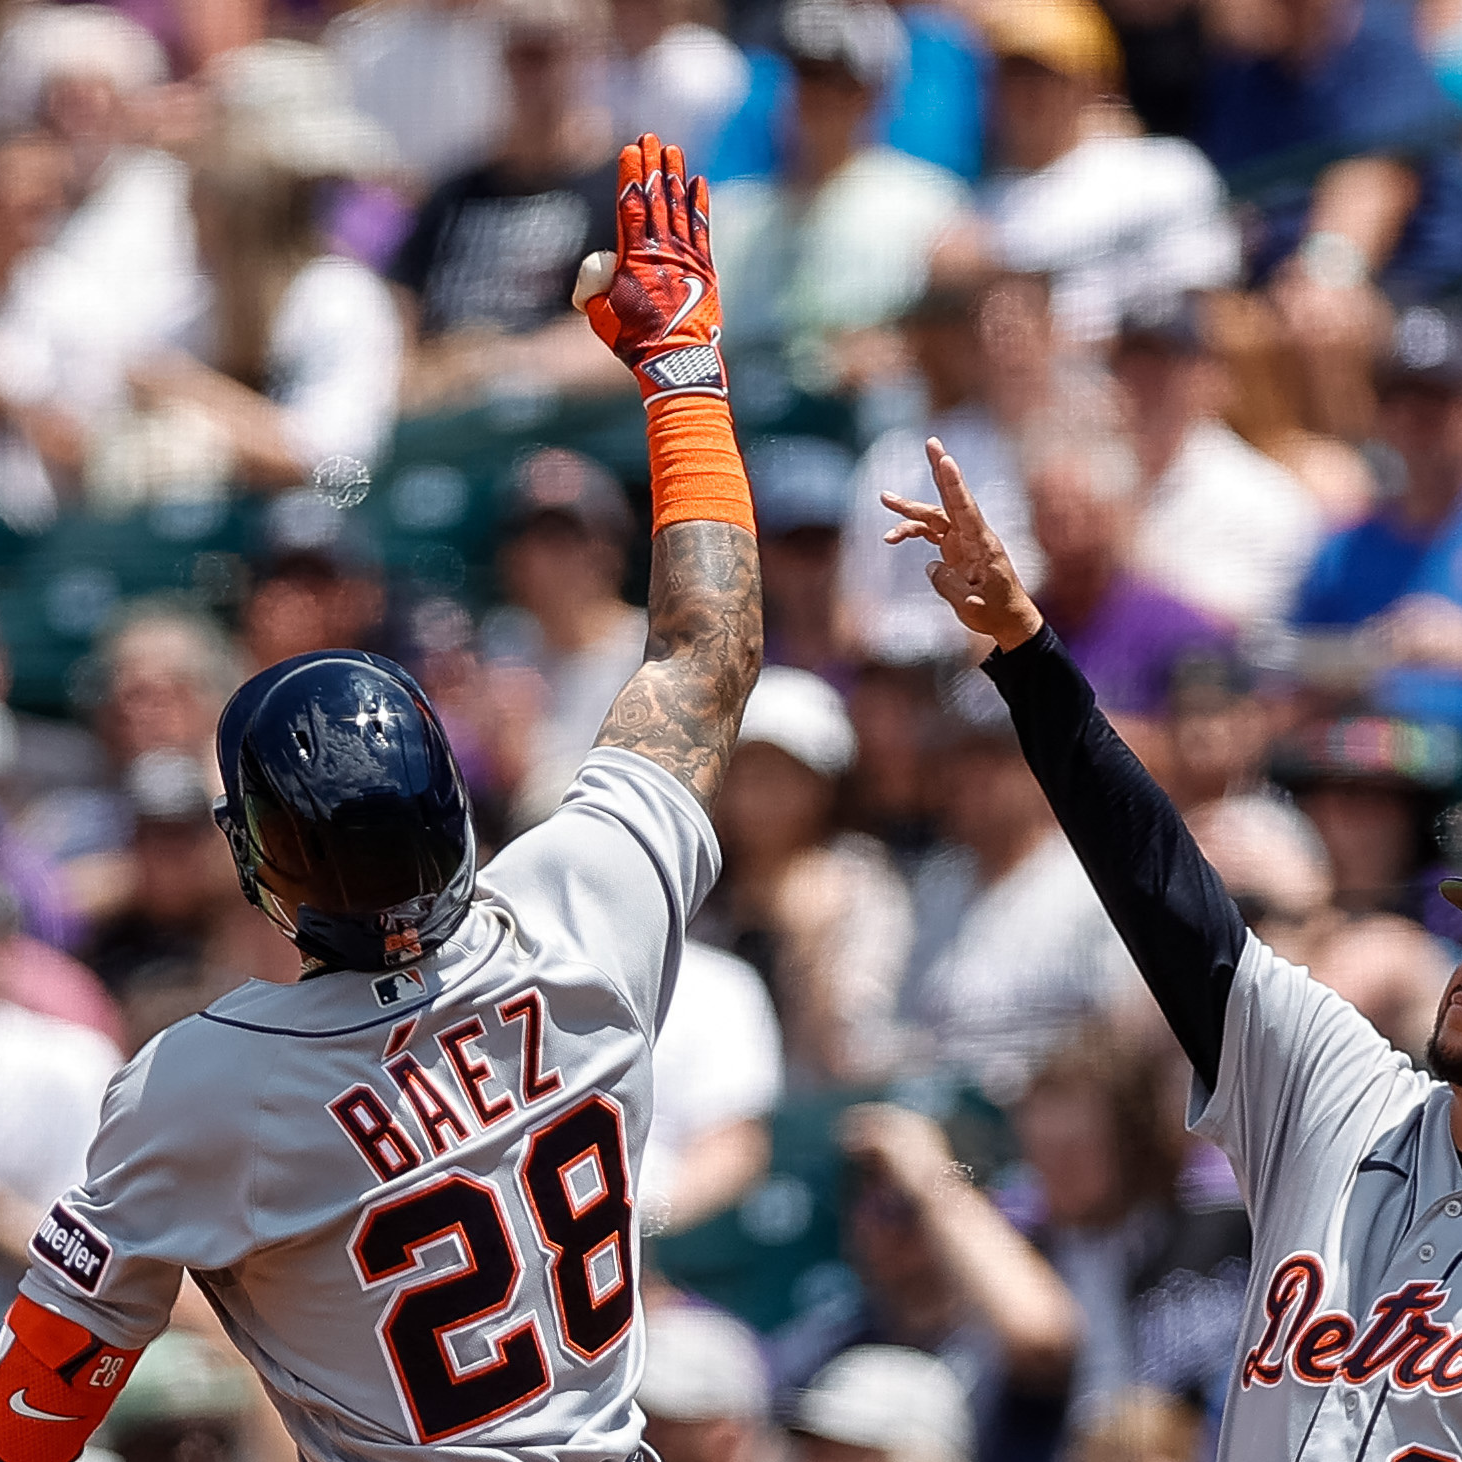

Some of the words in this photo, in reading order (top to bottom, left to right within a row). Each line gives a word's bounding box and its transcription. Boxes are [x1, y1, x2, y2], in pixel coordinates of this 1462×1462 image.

[325, 988, 565, 1184] BÁEZ
[39, 1214, 101, 1277] meijer
[346, 1090, 633, 1444] 28
[88, 1355, 125, 1388] 28
